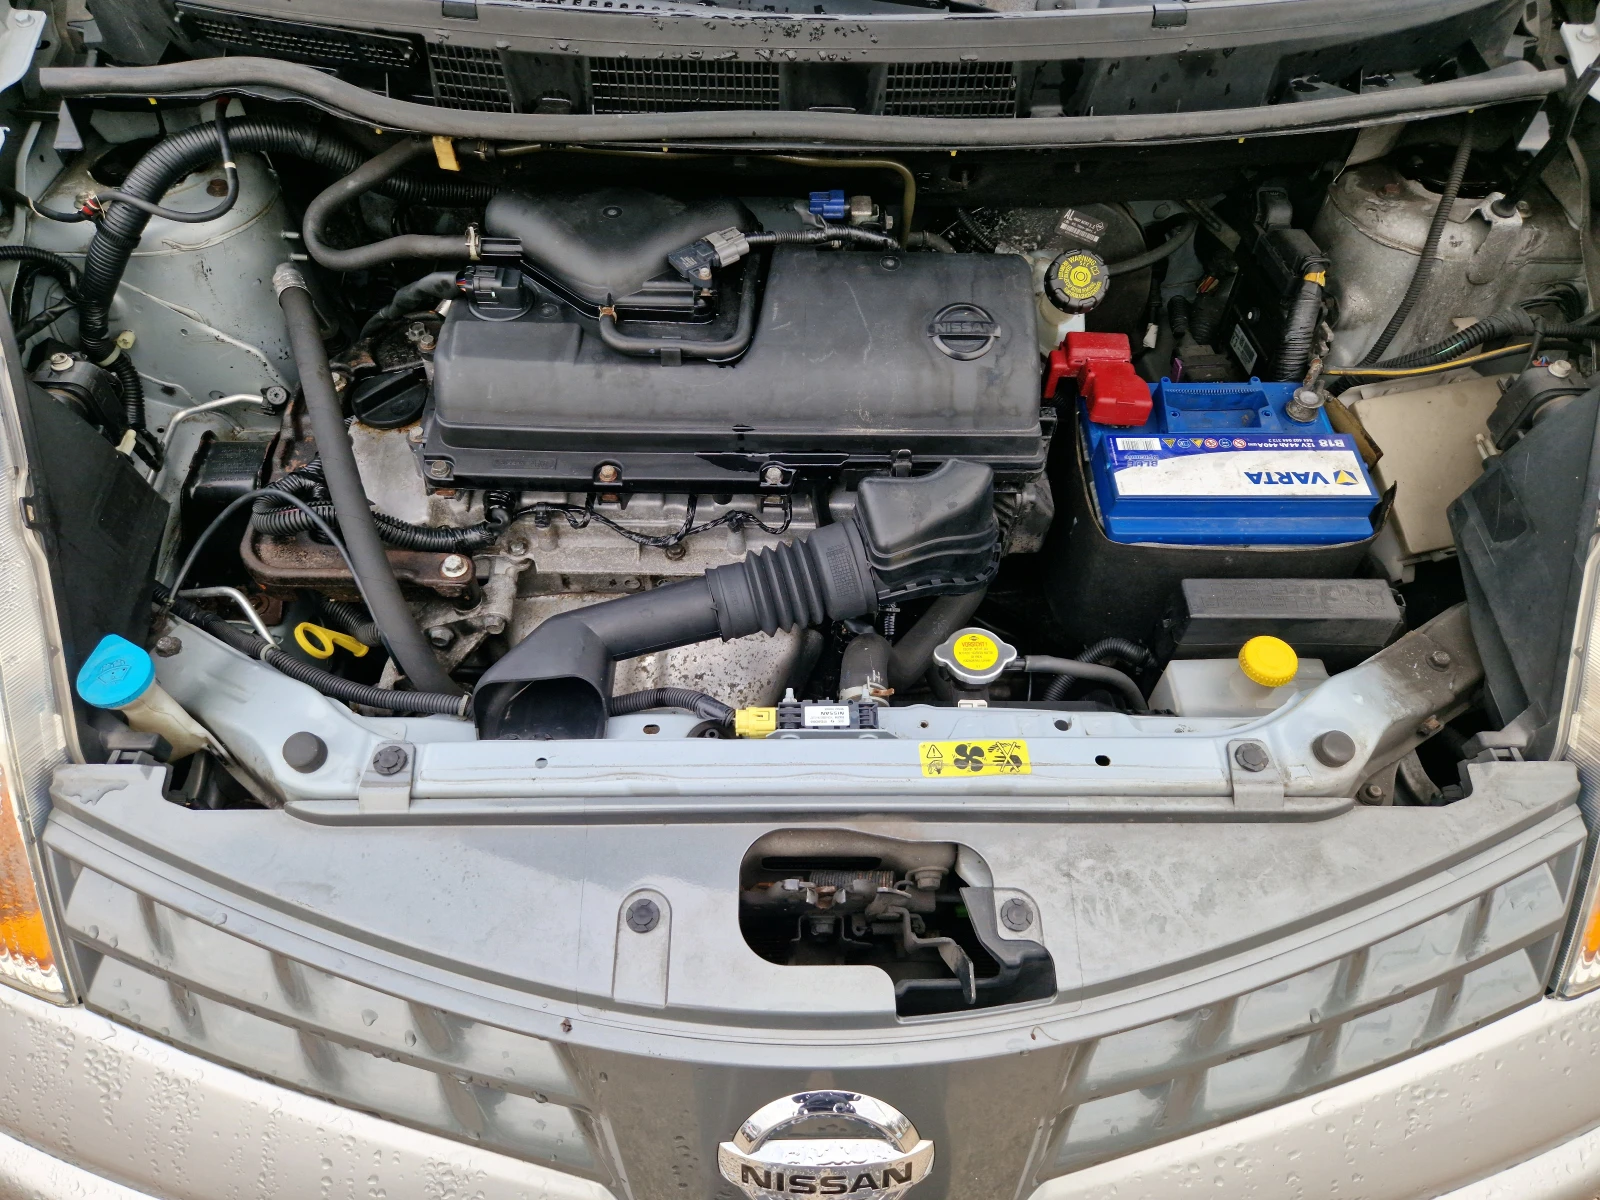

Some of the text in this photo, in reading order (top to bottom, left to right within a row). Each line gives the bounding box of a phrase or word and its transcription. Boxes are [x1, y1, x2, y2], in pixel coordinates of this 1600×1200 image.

[934, 322, 995, 334] NISSAN
[1318, 438, 1346, 448] B18
[1243, 471, 1331, 485] VARTA
[740, 1161, 913, 1195] NISSAN
